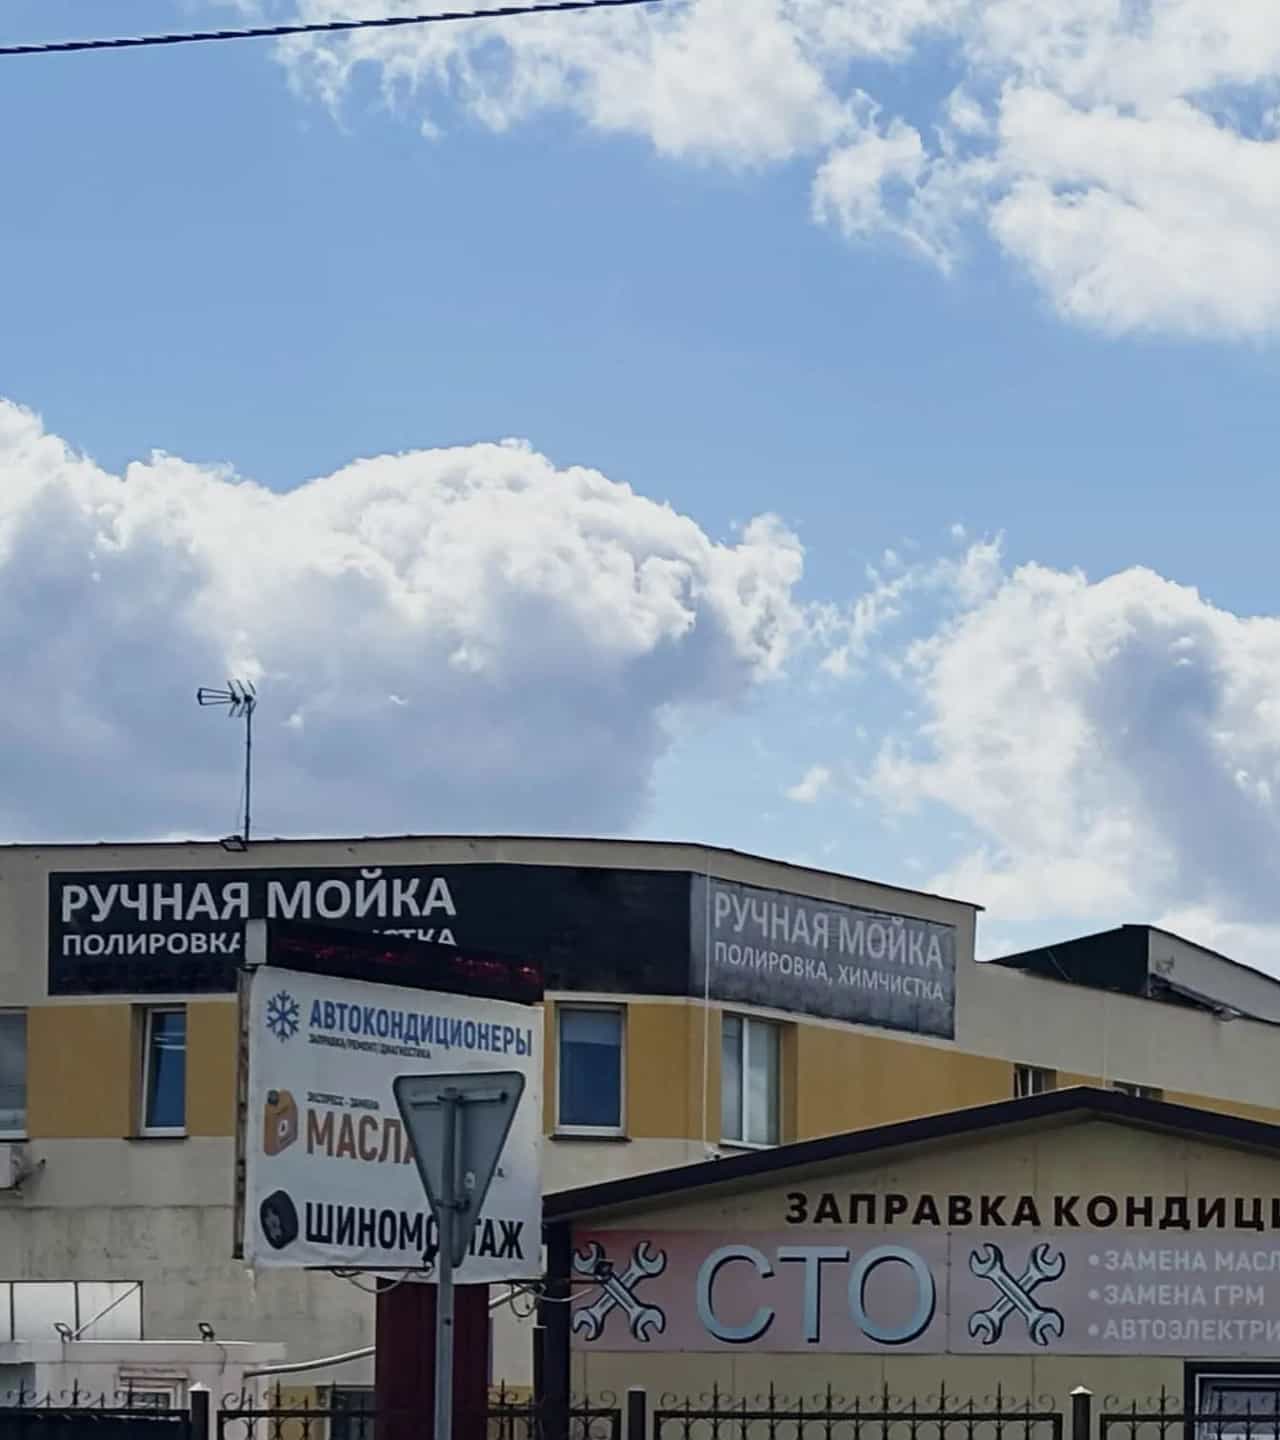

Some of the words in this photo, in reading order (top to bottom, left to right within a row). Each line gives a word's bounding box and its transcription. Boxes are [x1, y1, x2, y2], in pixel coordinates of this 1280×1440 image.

[62, 882, 249, 922] РУЧНАЯ
[267, 868, 457, 919] МОЙКА
[714, 891, 829, 949] РУЧНАЯ
[838, 916, 944, 969] МОЙКА
[715, 941, 833, 985] ПОЛИРОВКА,
[837, 964, 944, 1001] ХИМЧИСТКА
[310, 999, 533, 1056] АВТОКОНДИЦИОНЕРЫ
[306, 1202, 524, 1260] ШИНОМОТАЖ
[785, 1193, 1041, 1227] ЗАПРАВКА
[1104, 1250, 1207, 1271] ЗАМЕНА
[697, 1245, 936, 1345] СТО
[1104, 1284, 1206, 1305] ЗАМЕНА
[1215, 1285, 1265, 1306] ГРМ
